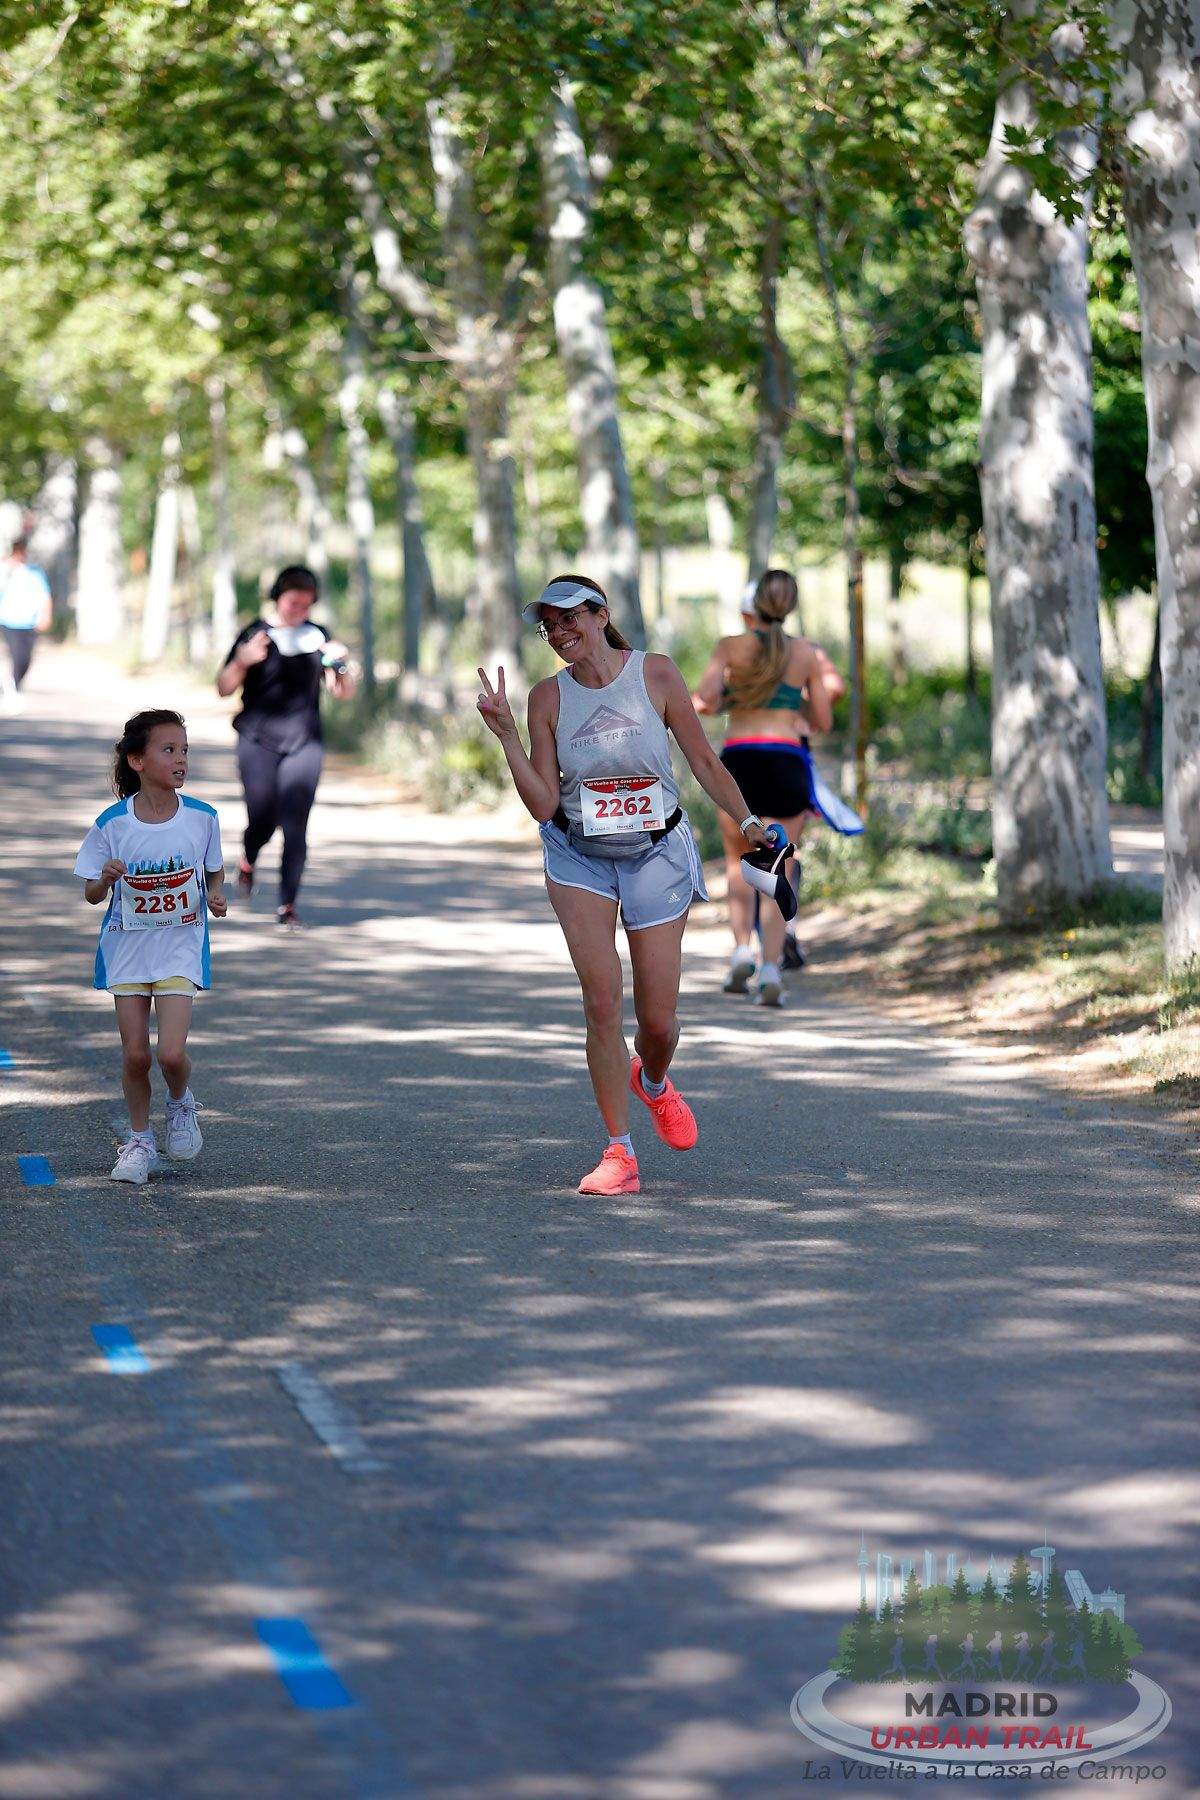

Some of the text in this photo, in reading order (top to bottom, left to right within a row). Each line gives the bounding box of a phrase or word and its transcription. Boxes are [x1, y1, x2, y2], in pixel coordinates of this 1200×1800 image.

[570, 730, 642, 749] NIKE TRAIL
[594, 796, 652, 818] 2262
[133, 891, 188, 913] 2281
